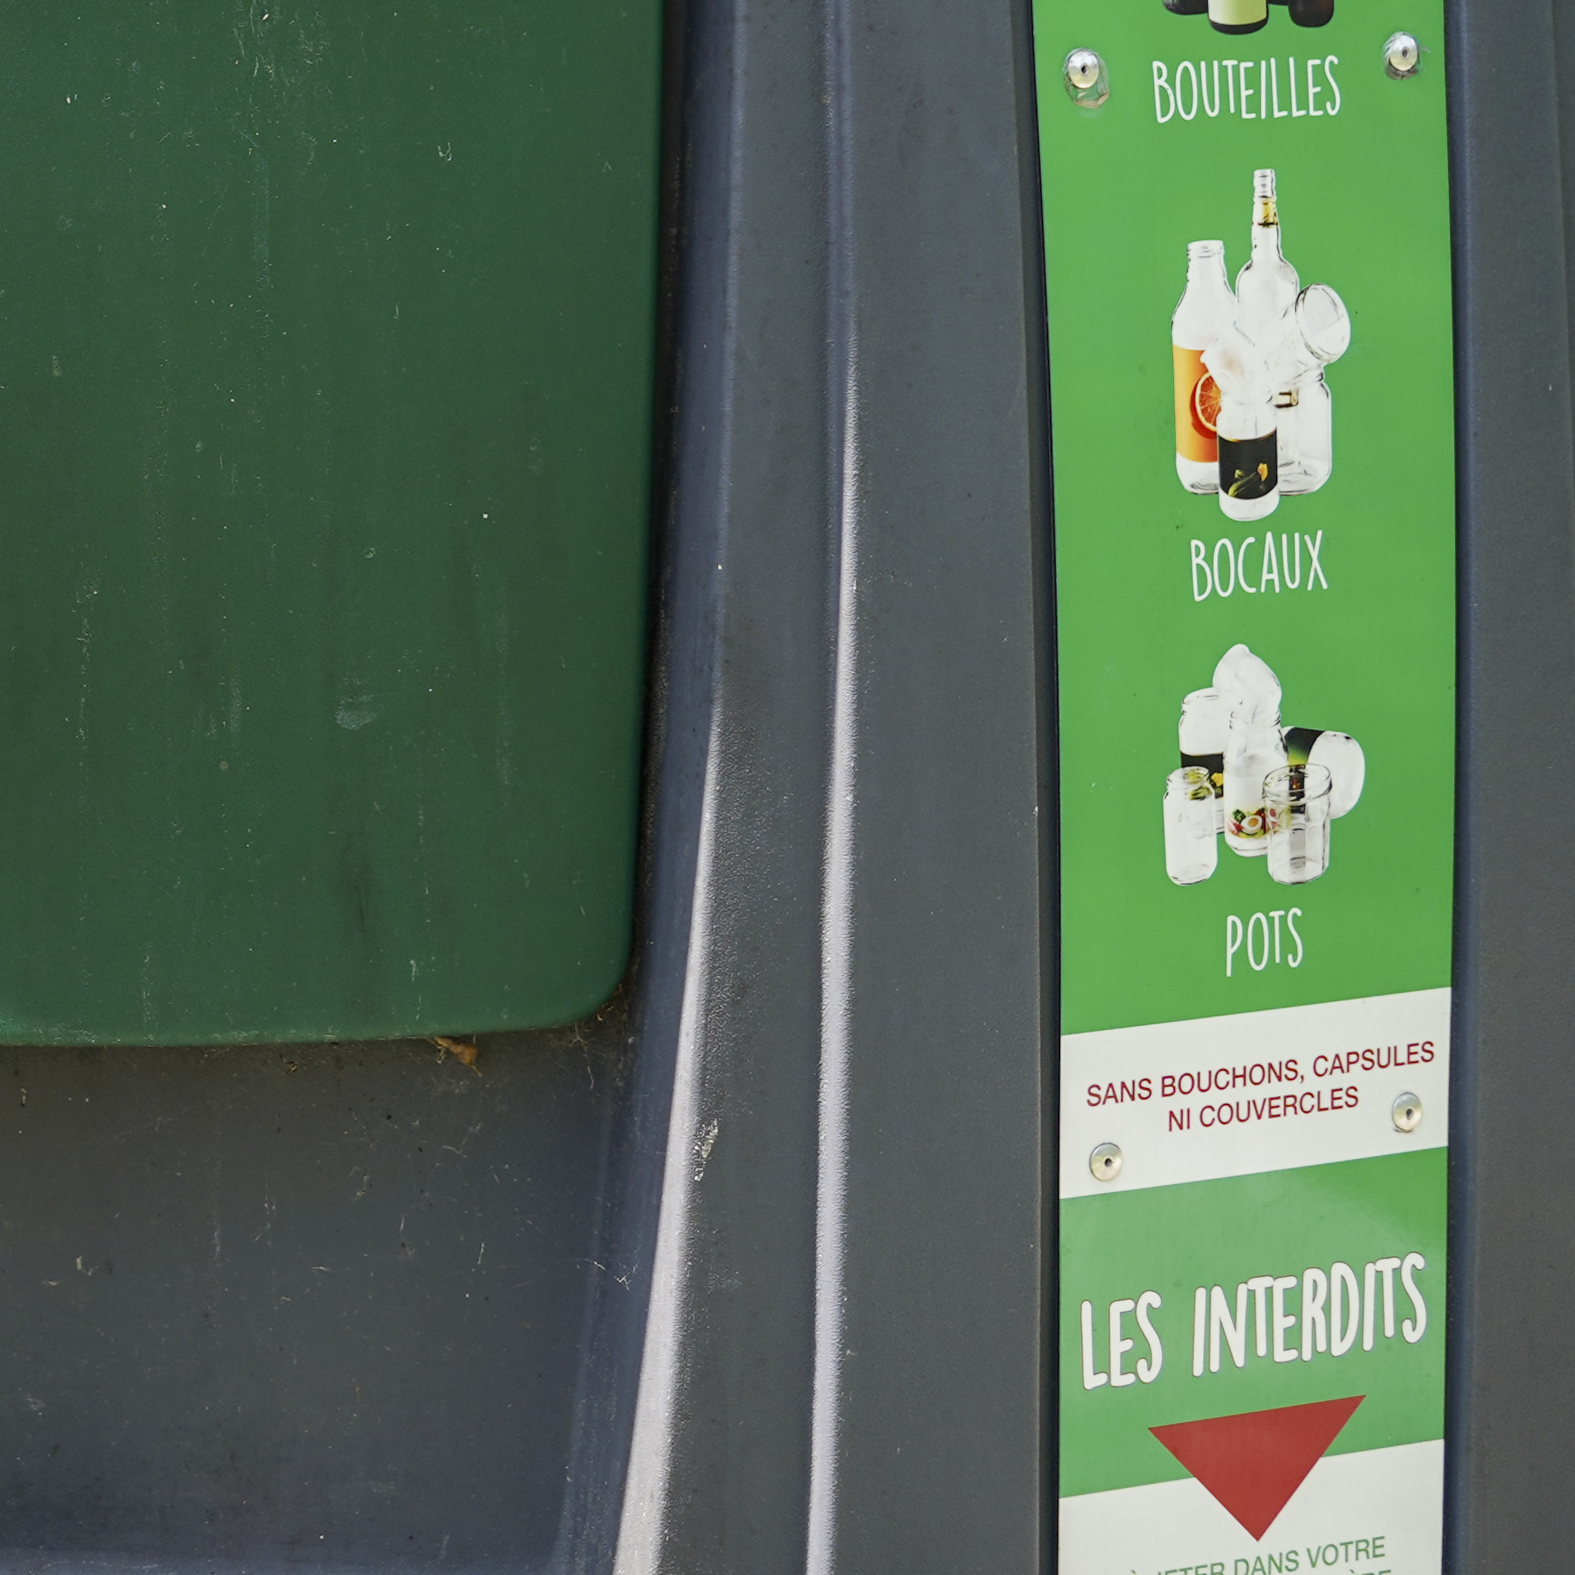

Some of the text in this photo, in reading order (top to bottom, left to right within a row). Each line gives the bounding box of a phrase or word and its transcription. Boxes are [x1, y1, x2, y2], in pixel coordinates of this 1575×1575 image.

[1152, 54, 1342, 124] BOUTEILLES
[1189, 529, 1329, 602] BOCAUX
[1225, 906, 1304, 978] POTS
[1085, 1039, 1436, 1108] SANS BOUCHONS, CAPSULES
[1167, 1084, 1360, 1133] NI COUVERCLES
[1080, 1251, 1429, 1392] LES INTERDITS
[1233, 1549, 1300, 1575] DANS
[1306, 1535, 1386, 1568] VOTRE
